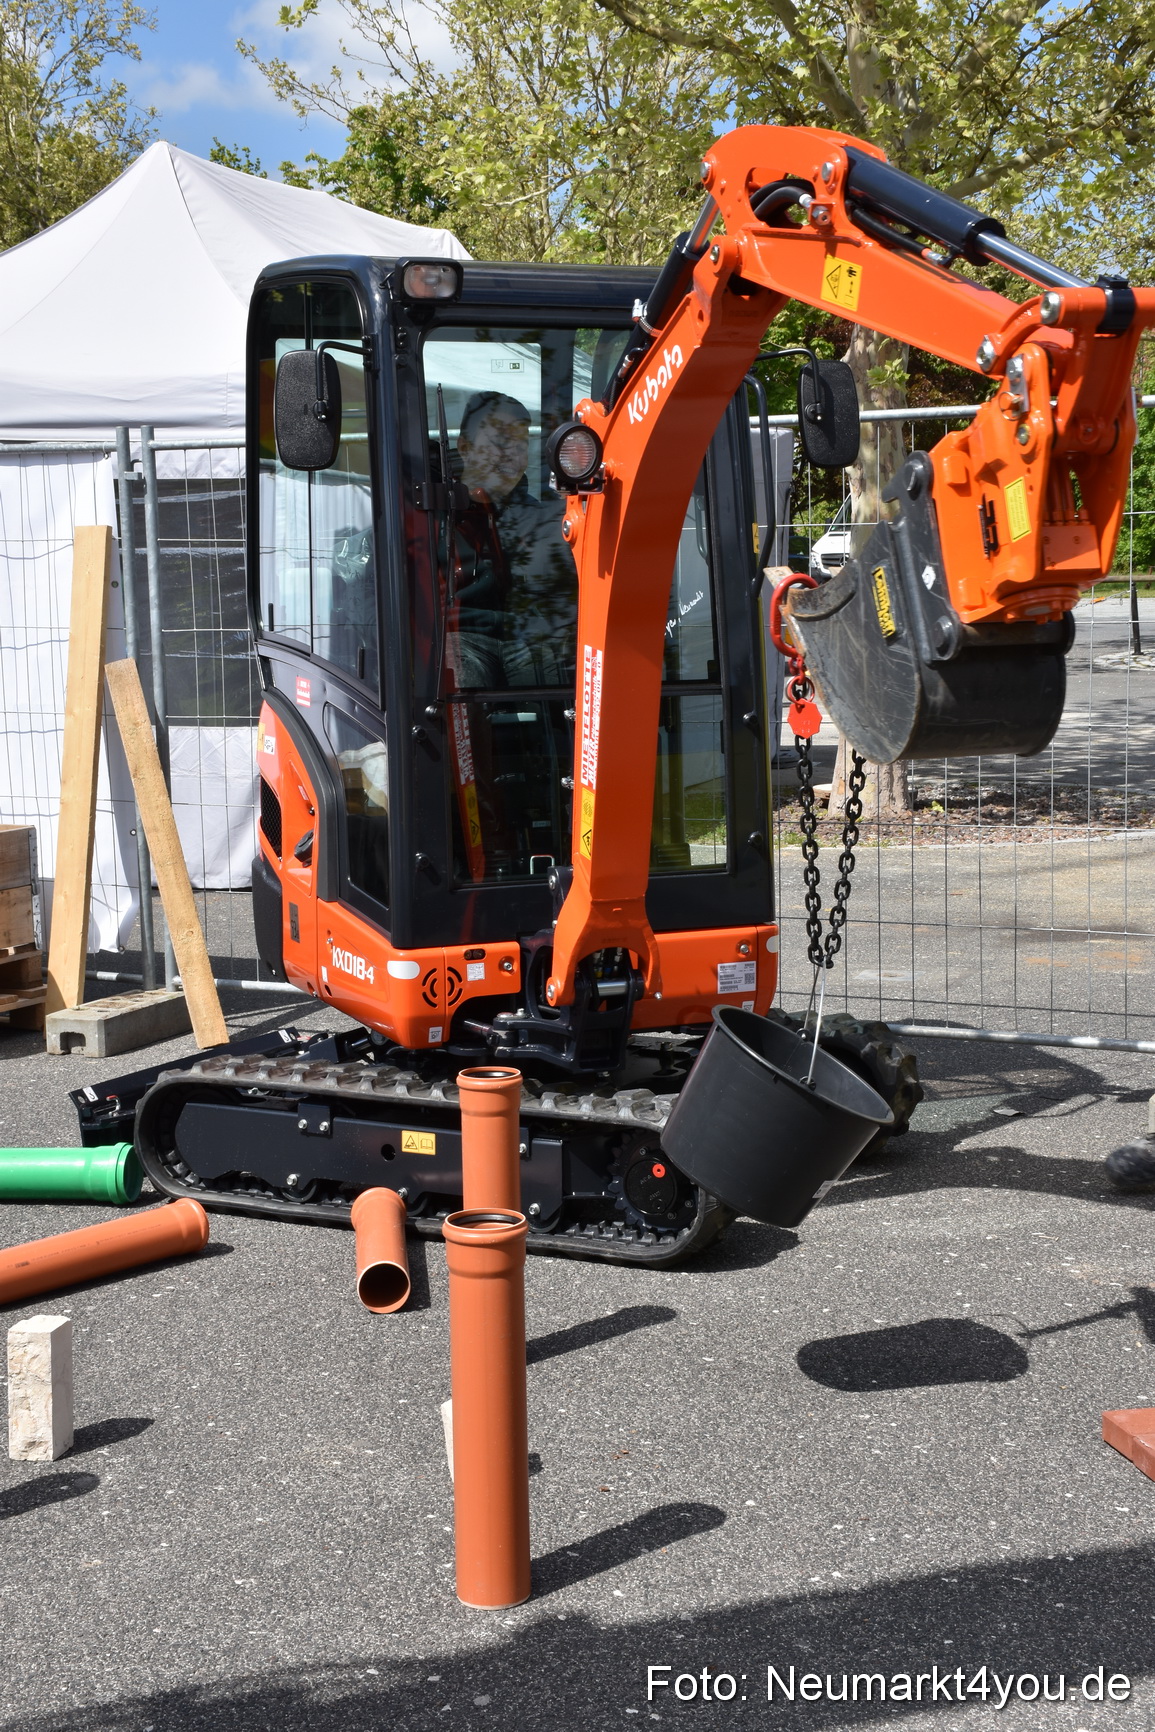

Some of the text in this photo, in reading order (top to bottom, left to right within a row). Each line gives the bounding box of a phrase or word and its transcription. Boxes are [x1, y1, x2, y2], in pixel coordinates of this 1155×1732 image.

[627, 344, 684, 425] Kubota
[582, 648, 592, 781] MIETFLOTTE
[332, 945, 375, 985] KX018-4
